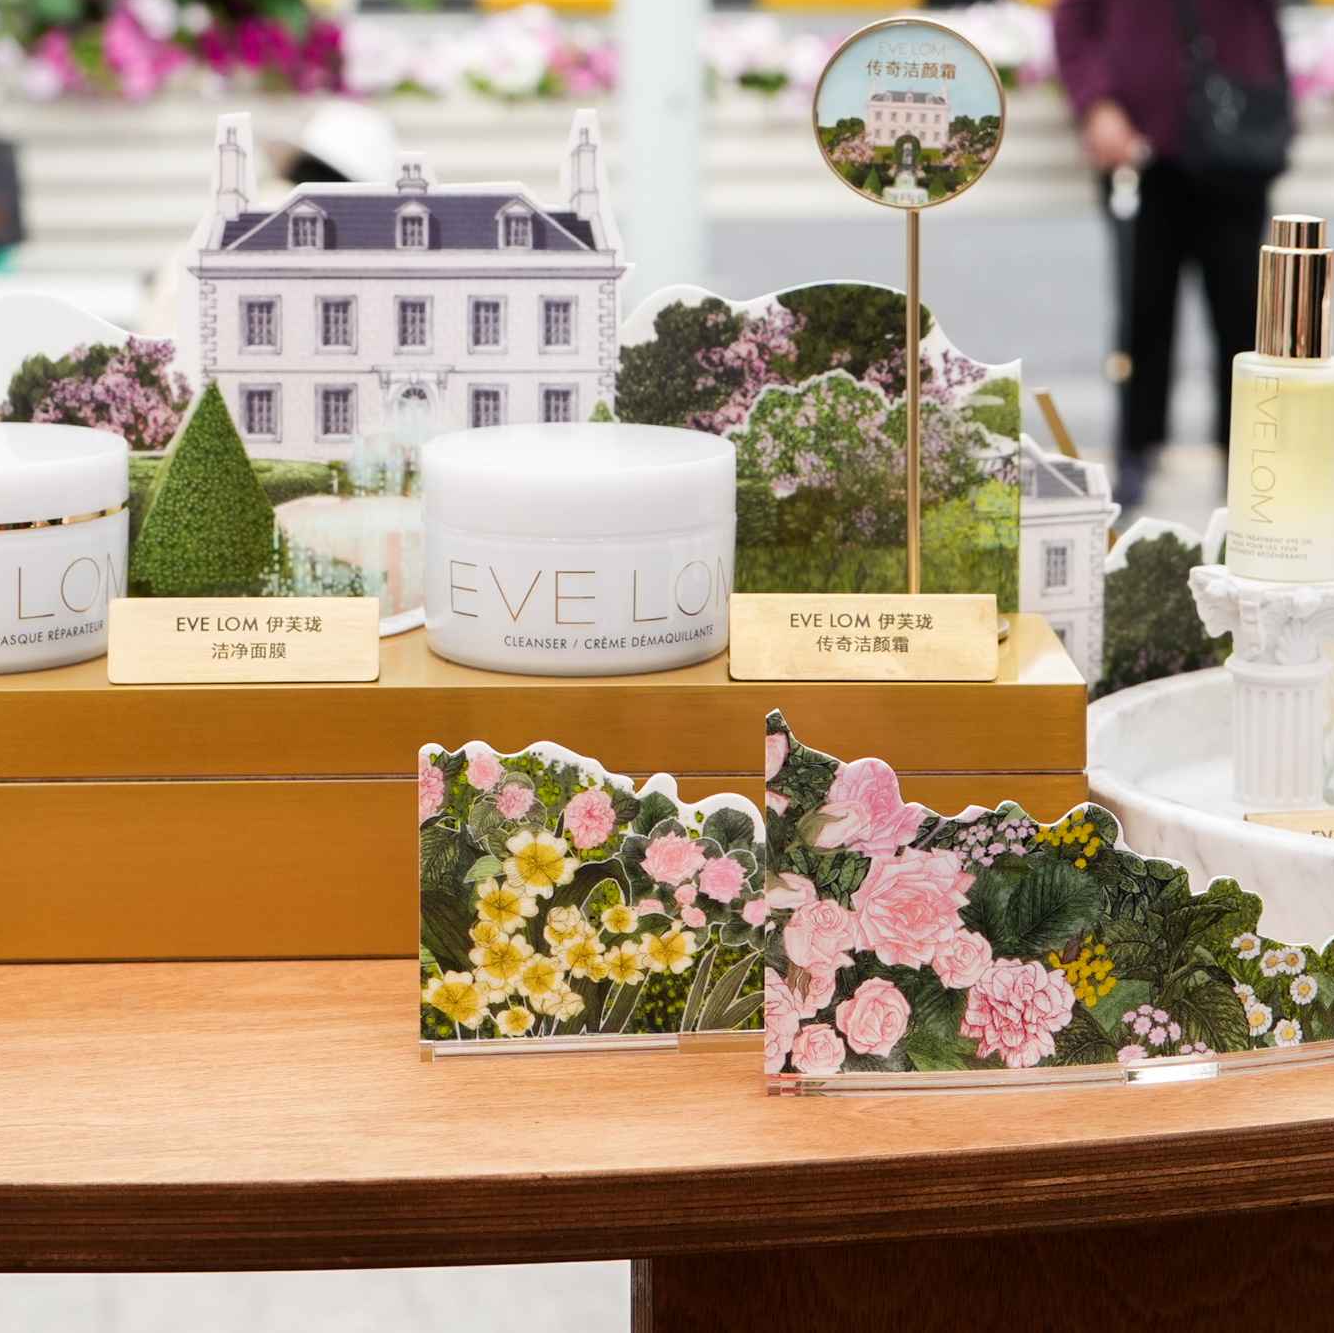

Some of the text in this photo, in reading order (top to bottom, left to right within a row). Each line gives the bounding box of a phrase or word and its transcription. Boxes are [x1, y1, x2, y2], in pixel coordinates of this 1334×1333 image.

[877, 41, 946, 56] EVE LOM
[866, 59, 957, 80] 传奇洁颜霜
[1249, 375, 1279, 524] EVE LOM
[450, 560, 596, 625] EVE
[47, 620, 104, 641] RÉPARATEUR
[176, 615, 323, 634] EVE LOM 伊芙珑
[790, 613, 933, 630] EVE LOM 伊芙珑
[504, 635, 567, 649] CLEANSER
[584, 634, 627, 649] CRÈME
[631, 623, 714, 648] DÉMAQUILLANTE
[816, 635, 910, 653] 传奇洁颜霜
[211, 642, 288, 660] 洁净面膜
